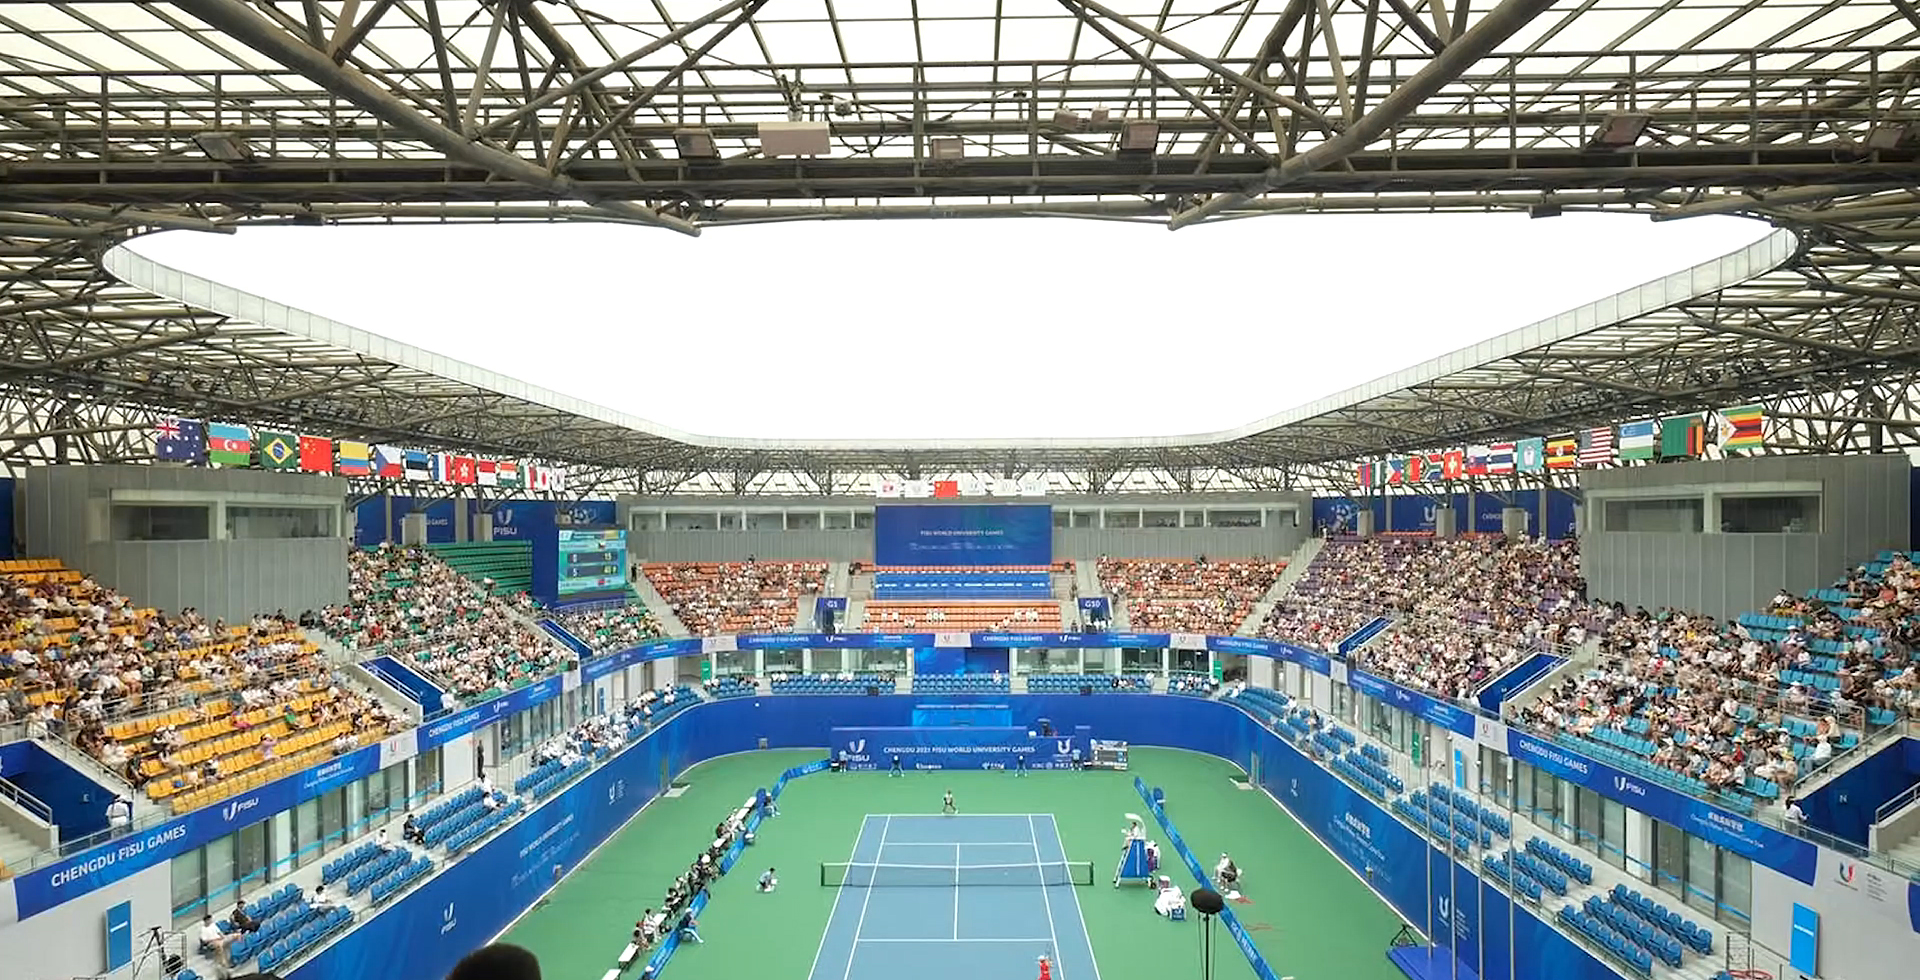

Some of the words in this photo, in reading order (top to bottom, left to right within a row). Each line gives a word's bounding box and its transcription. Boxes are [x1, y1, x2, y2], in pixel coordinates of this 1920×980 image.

[51, 851, 116, 887] CHENGDU
[118, 841, 145, 861] FISU
[147, 824, 186, 849] GAMES
